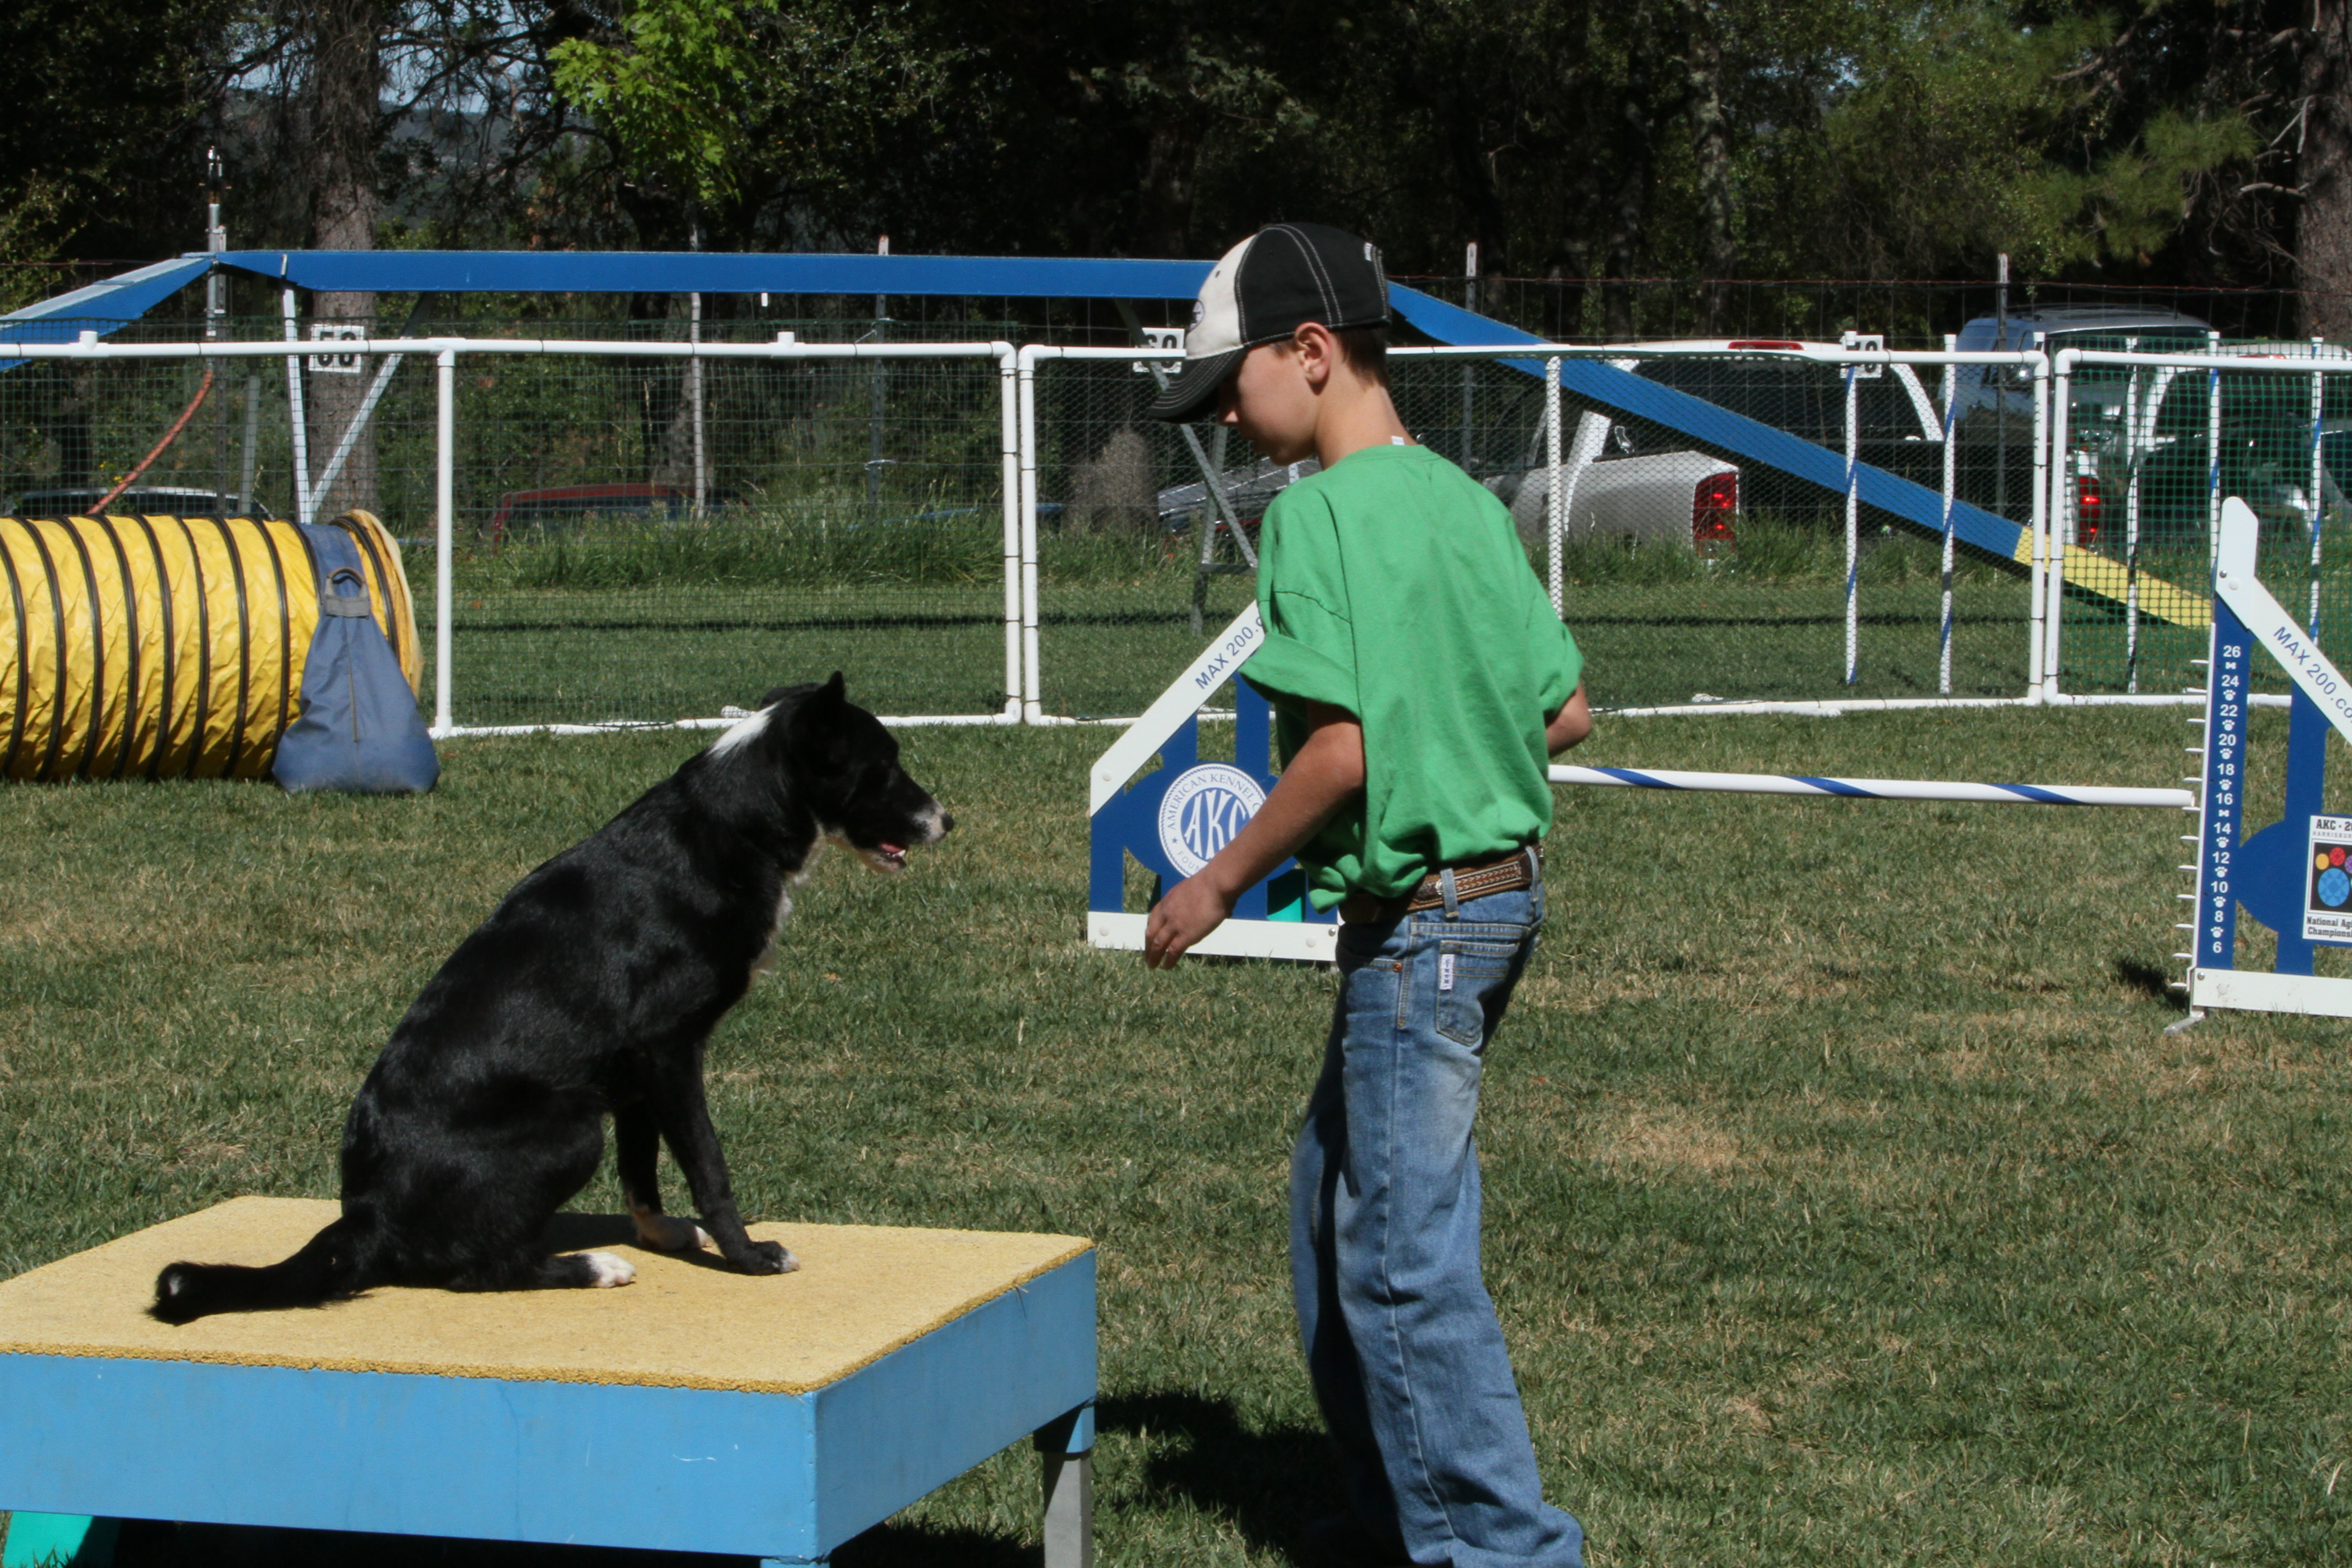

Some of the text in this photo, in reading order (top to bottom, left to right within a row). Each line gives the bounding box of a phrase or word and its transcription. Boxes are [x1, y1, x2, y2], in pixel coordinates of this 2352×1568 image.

[1195, 617, 1263, 689] MAX 200.c
[2223, 645, 2241, 658] 26
[2273, 626, 2352, 721] MAX 200.co
[2221, 674, 2239, 687] 24
[2220, 704, 2238, 717] 22
[2219, 733, 2237, 746] 20
[2217, 763, 2235, 776] 18
[1167, 773, 1255, 830] AMERICAN KENNEL
[2215, 793, 2233, 805] 16
[1184, 789, 1247, 861] AKC
[2214, 822, 2231, 835] 14
[2316, 818, 2336, 830] AKC
[2212, 851, 2230, 864] 12
[2210, 881, 2229, 893] 10
[2214, 910, 2224, 923] 8
[2307, 916, 2338, 926] National
[2212, 941, 2222, 954] 6
